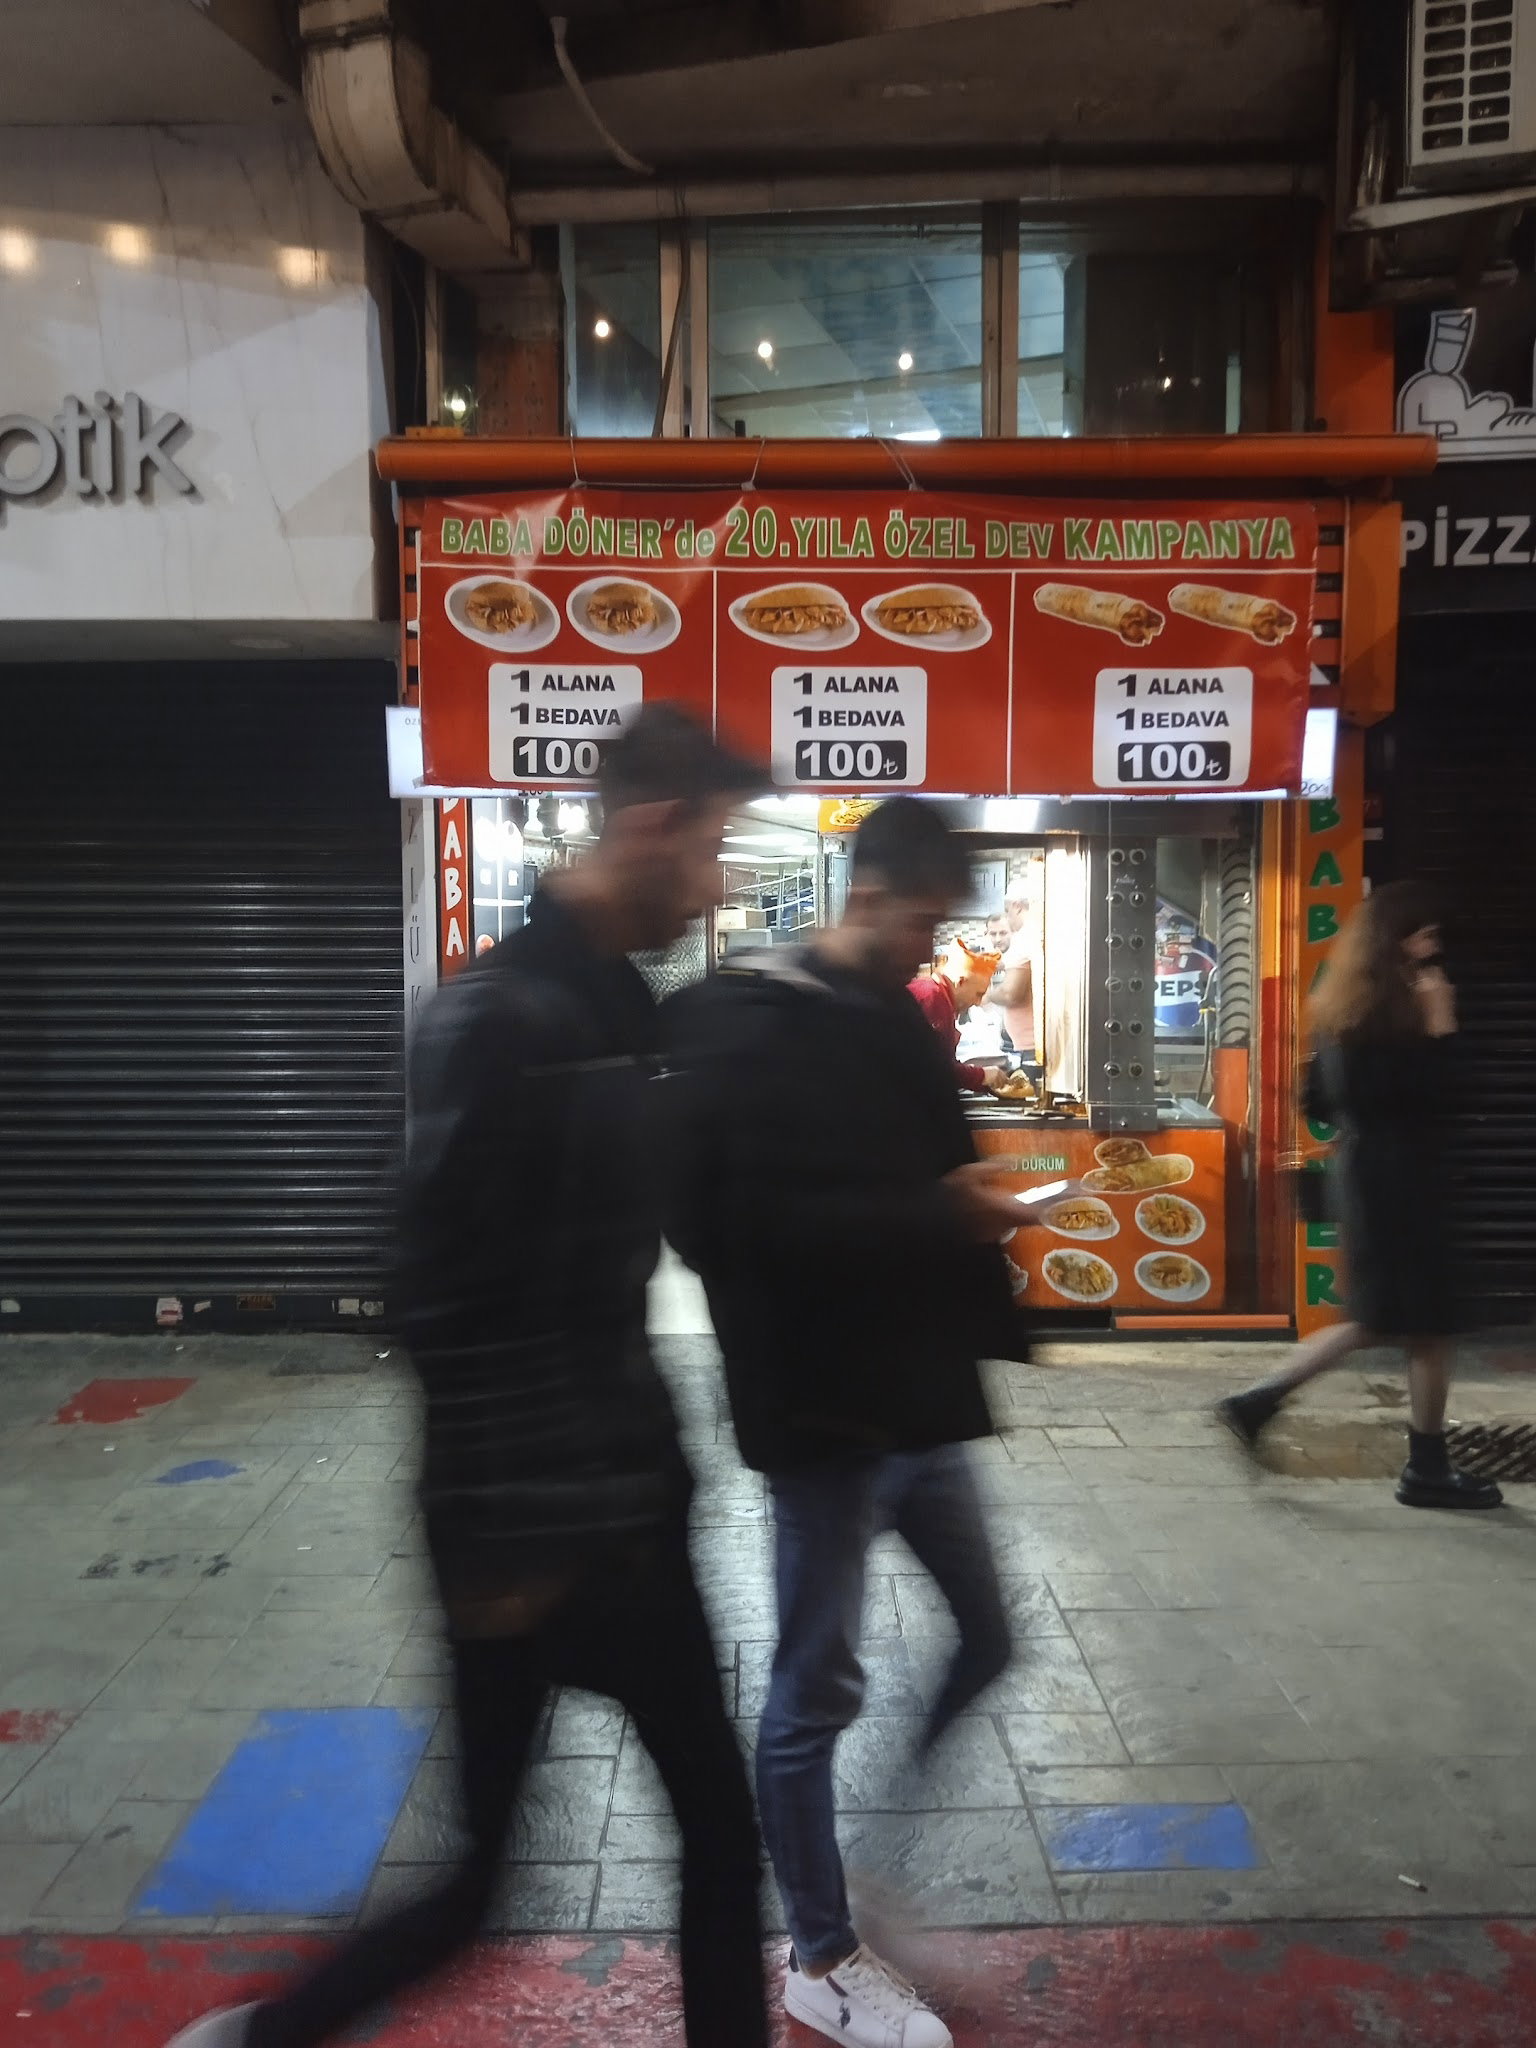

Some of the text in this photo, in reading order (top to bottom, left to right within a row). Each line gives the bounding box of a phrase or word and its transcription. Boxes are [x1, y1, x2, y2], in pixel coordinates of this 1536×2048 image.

[441, 517, 534, 556] BABA
[885, 510, 975, 559] ÖZEL
[986, 518, 1054, 559] DEV
[1064, 516, 1295, 560] KAMPANYA
[1400, 506, 1536, 567] PİZZ
[511, 670, 615, 693] 1 ALANA
[794, 672, 899, 695] 1 ALANA
[1117, 674, 1223, 697] 1 ALANA
[510, 703, 621, 726] 1 BEDAVA
[793, 706, 905, 729] 1 BEDAVA
[1116, 708, 1229, 731] 1 BEDAVA
[518, 740, 607, 775] 100
